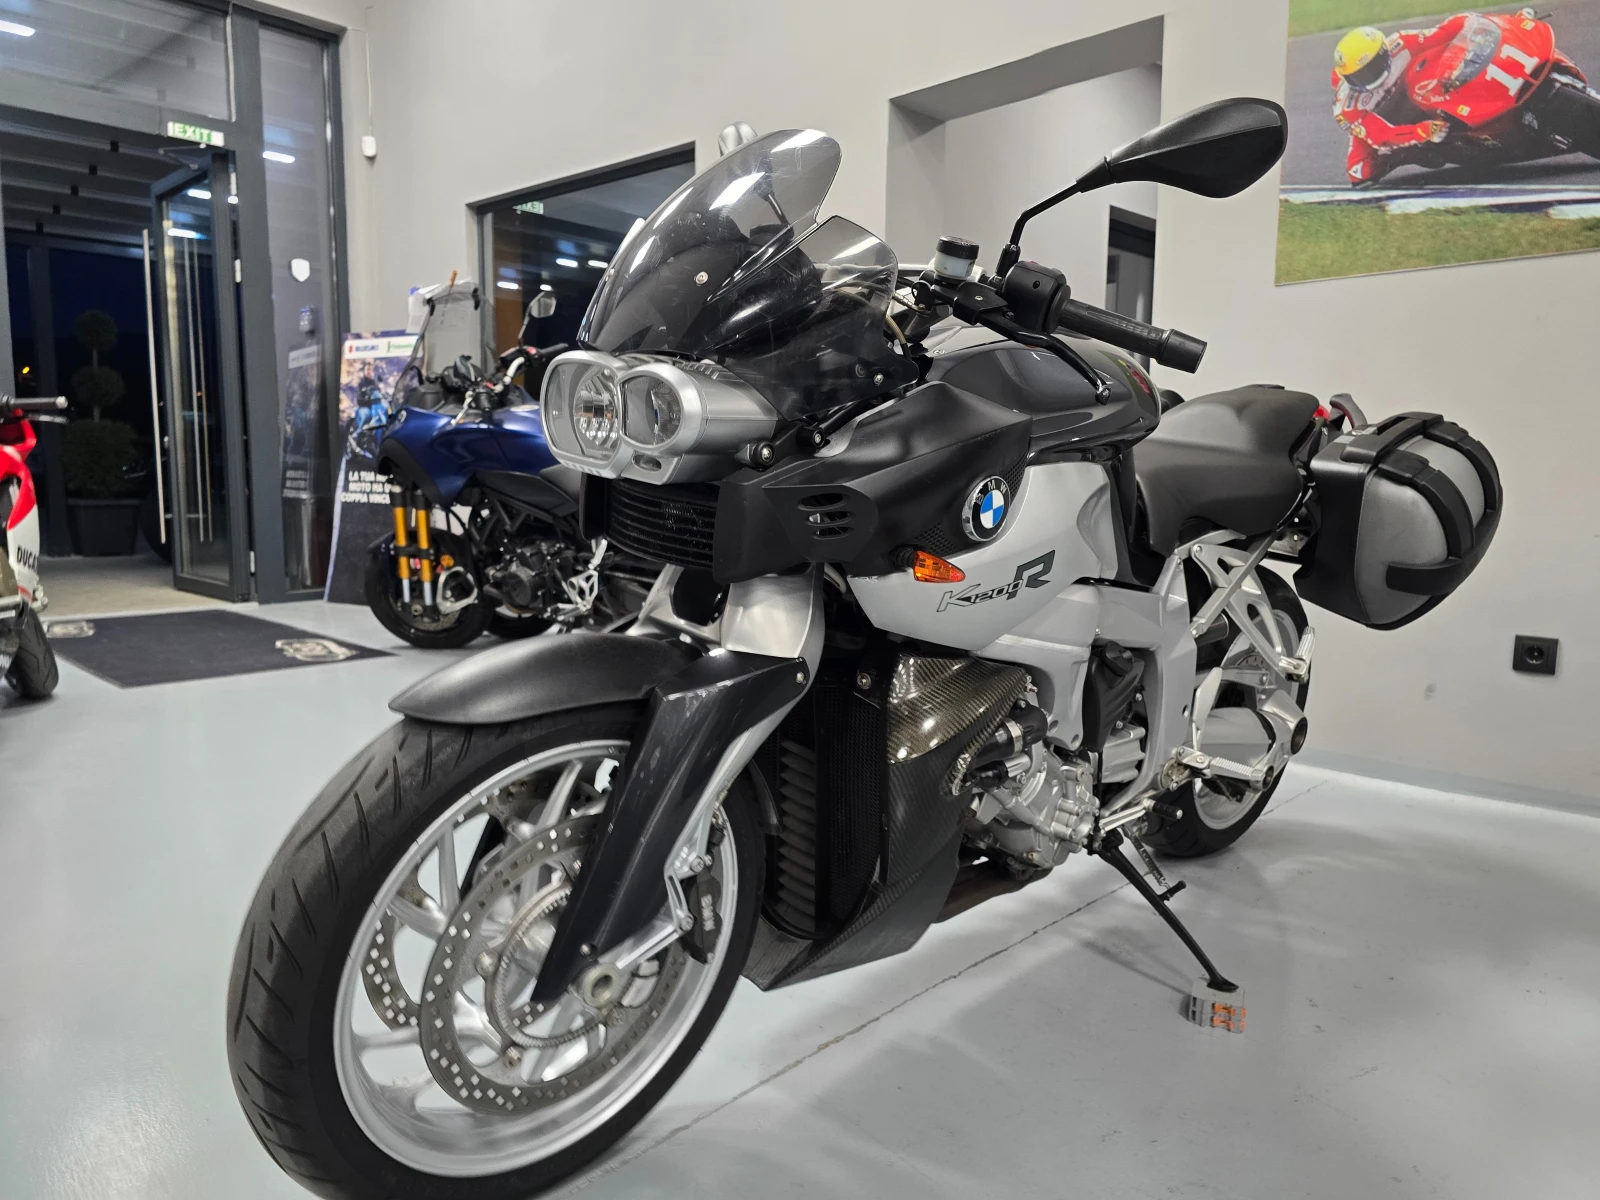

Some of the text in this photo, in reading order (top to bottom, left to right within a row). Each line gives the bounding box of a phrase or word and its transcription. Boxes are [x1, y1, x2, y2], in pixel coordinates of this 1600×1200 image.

[1485, 43, 1540, 96] 11
[174, 122, 211, 144] EXIT
[348, 470, 360, 482] LA
[360, 471, 376, 482] TUA
[348, 482, 371, 493] MOTO
[372, 483, 384, 493] HA
[975, 479, 1007, 505] BMW
[340, 491, 369, 504] COPPIA
